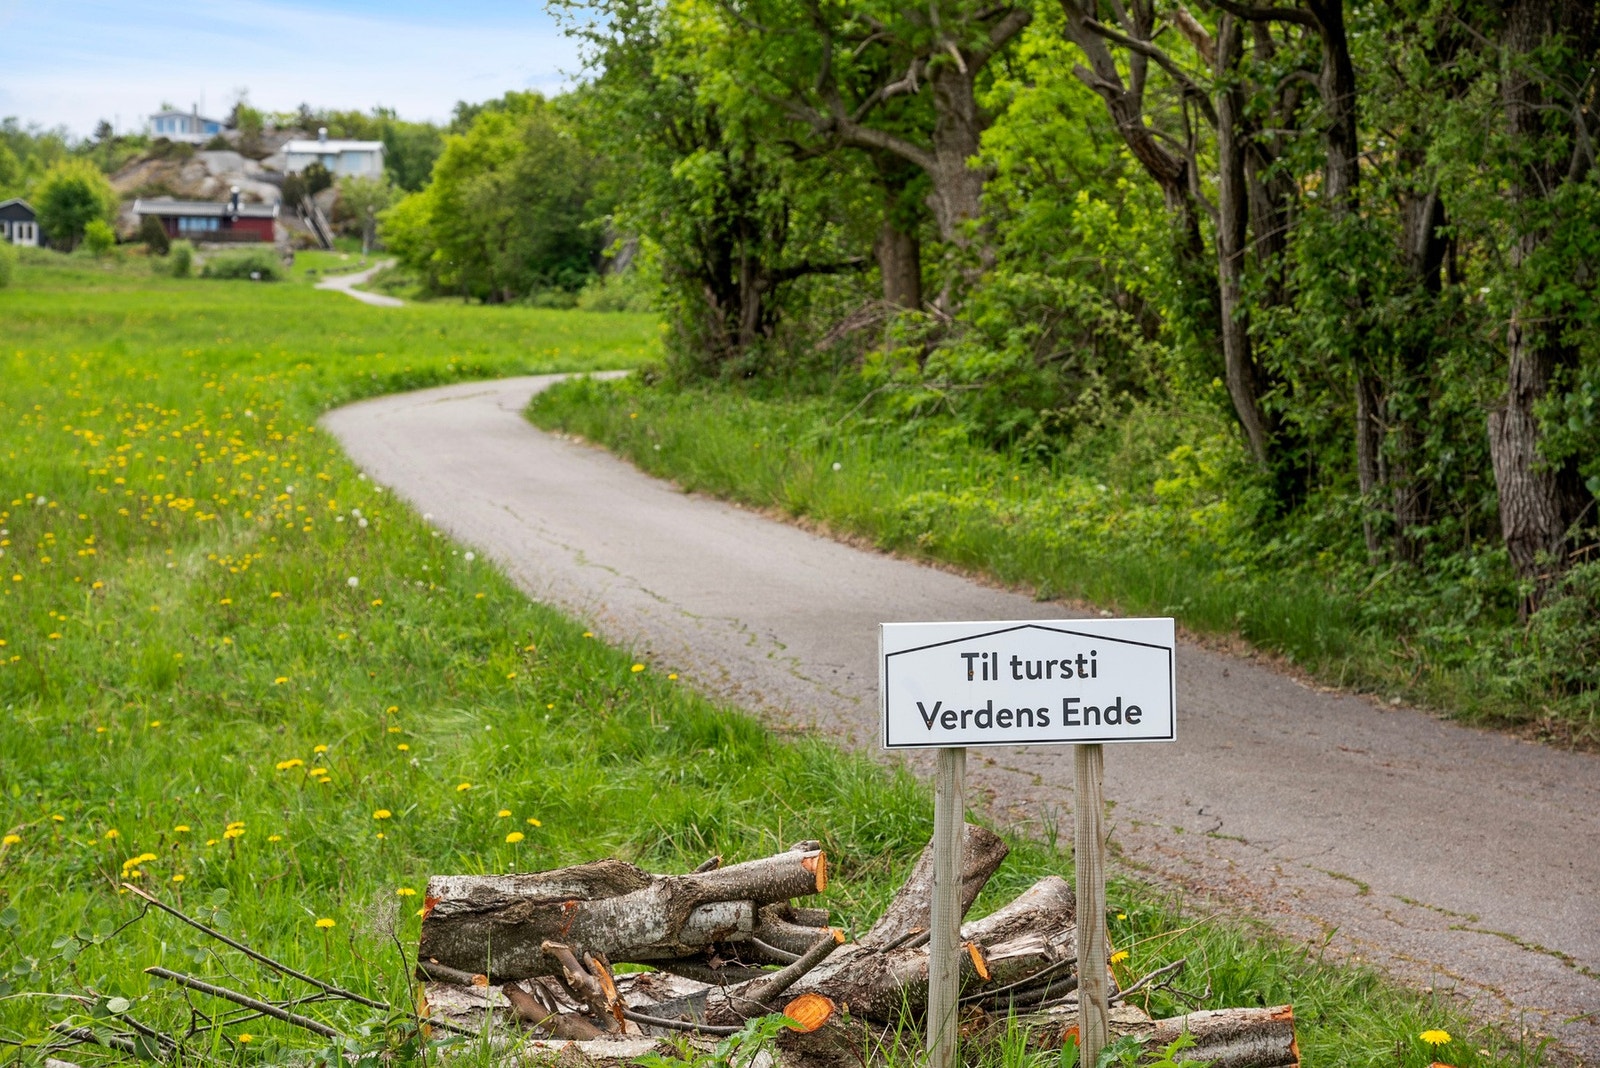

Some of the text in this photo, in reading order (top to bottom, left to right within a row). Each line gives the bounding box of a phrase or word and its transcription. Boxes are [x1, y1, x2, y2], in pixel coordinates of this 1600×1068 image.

[960, 650, 1098, 681] Til tursti
[916, 696, 1143, 731] Verdens Ende
